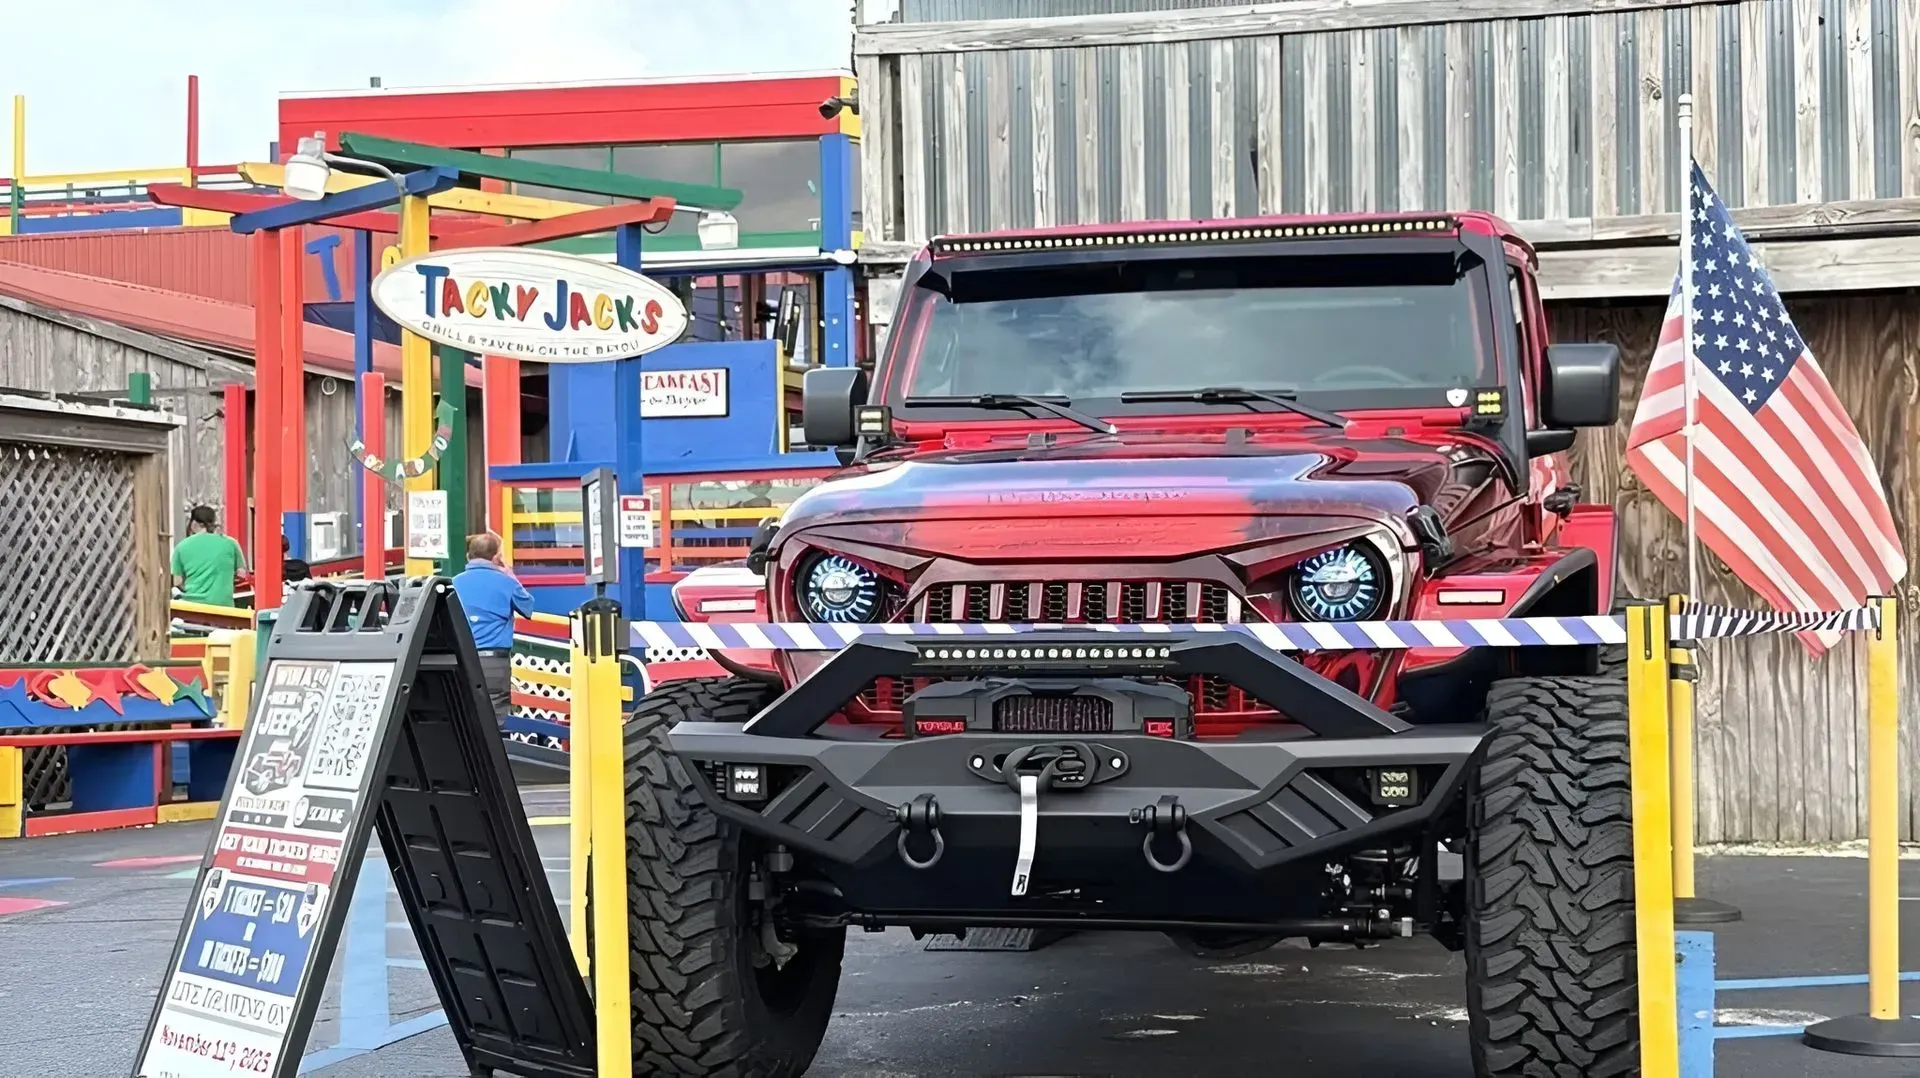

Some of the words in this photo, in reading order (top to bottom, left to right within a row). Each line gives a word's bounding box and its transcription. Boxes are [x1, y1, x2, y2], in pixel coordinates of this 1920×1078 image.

[416, 264, 539, 321] TACKY
[544, 279, 663, 334] JACK'S
[422, 320, 462, 342] GRILL
[480, 337, 534, 353] TAVERN
[538, 345, 558, 357] ON
[563, 346, 590, 357] THE
[641, 372, 719, 397] EAKFAST
[258, 708, 300, 735] JEEP
[330, 807, 345, 824] ME
[171, 980, 203, 1005] LIVE
[267, 1003, 291, 1026] ON
[160, 1024, 212, 1056] November
